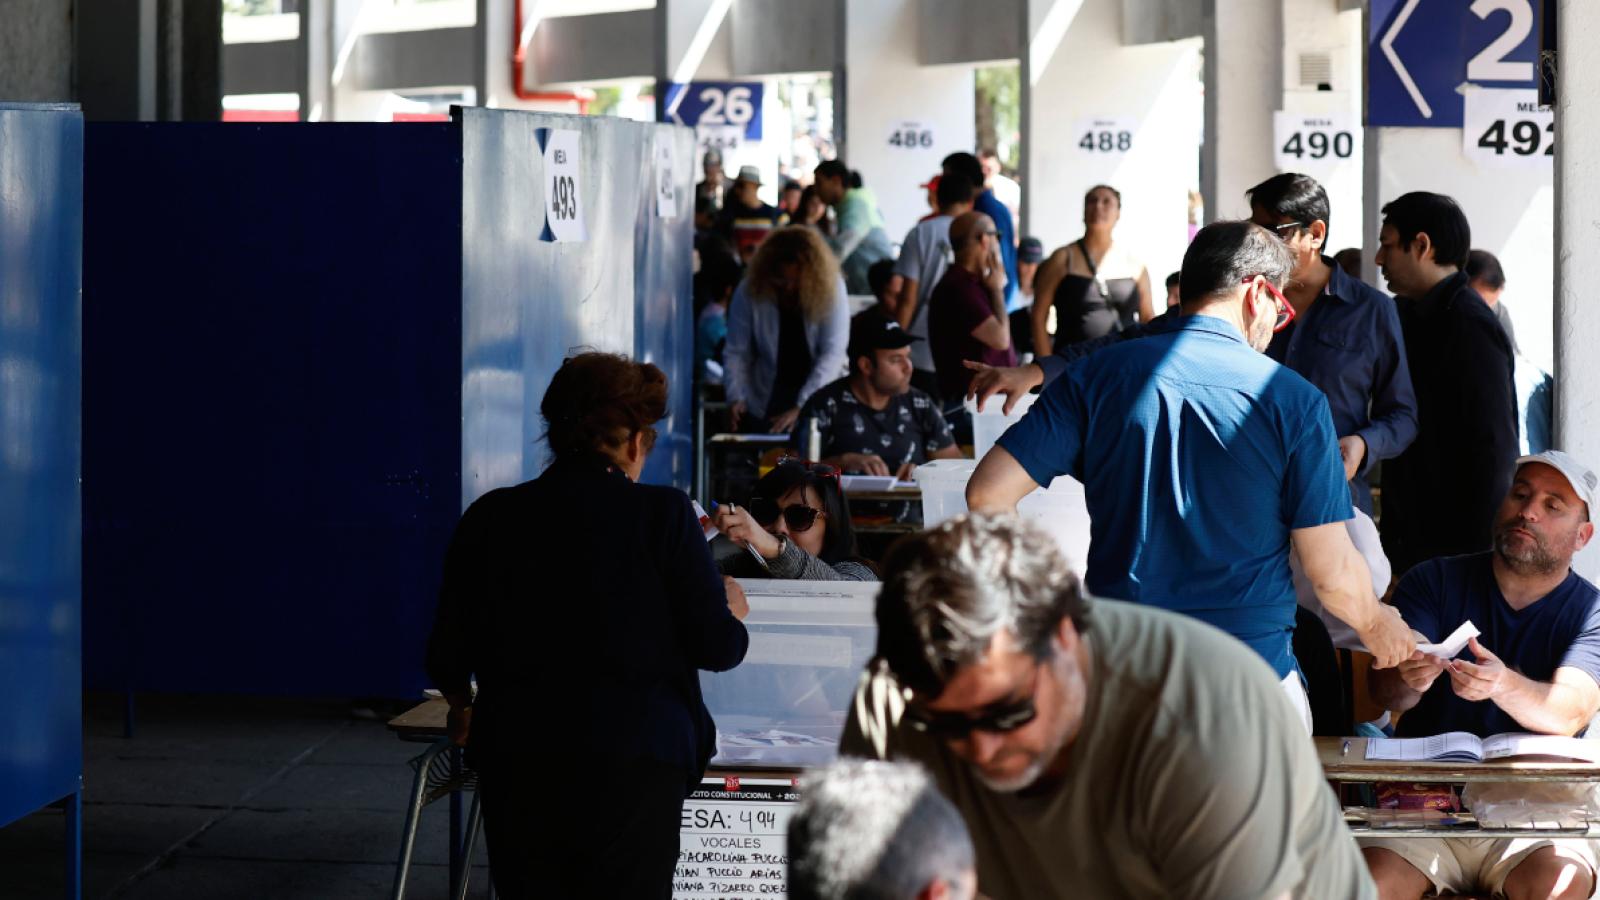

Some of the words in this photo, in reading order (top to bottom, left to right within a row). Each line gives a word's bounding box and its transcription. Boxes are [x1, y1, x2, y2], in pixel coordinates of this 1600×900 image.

[699, 86, 754, 125] 26
[1517, 102, 1552, 112] MES
[888, 130, 933, 148] 486
[1078, 130, 1132, 152] 488
[1283, 131, 1353, 158] 490
[552, 175, 577, 220] 493
[690, 790, 709, 798] CITO
[711, 790, 772, 799] CONSTITUCIONAL
[680, 809, 731, 829] ESA:
[740, 810, 775, 833] 494
[701, 837, 762, 849] VOCALES
